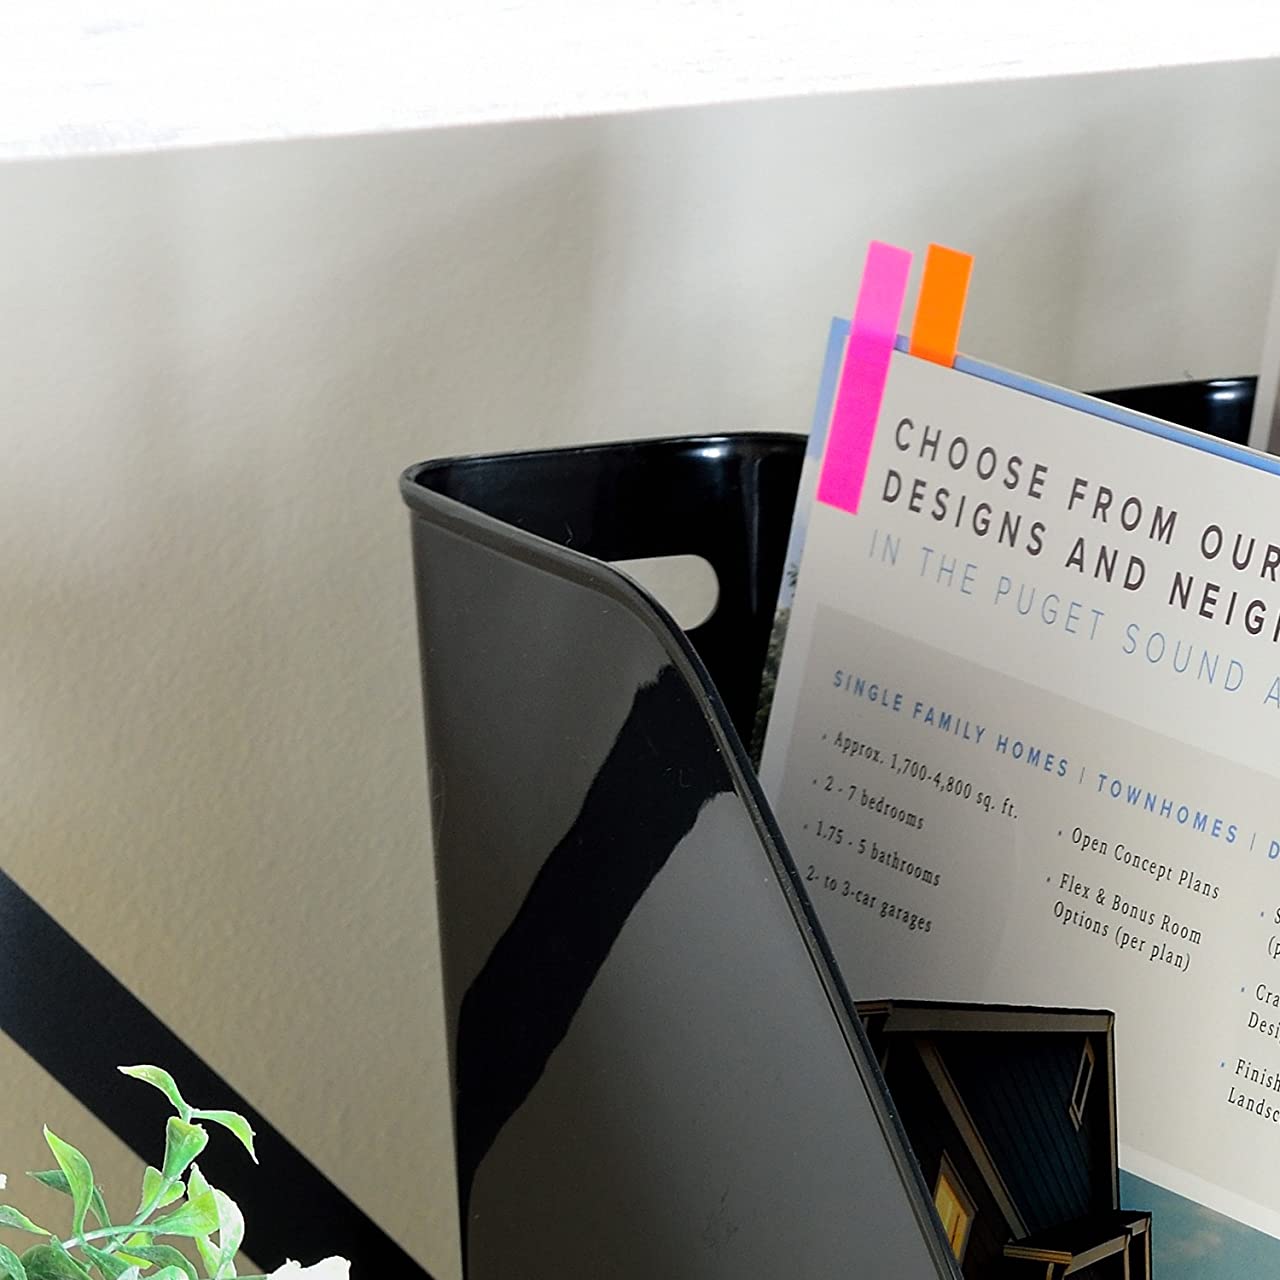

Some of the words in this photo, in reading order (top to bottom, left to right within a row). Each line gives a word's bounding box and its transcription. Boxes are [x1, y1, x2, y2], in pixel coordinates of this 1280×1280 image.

[895, 418, 1048, 499] CHOOSE
[1067, 477, 1178, 545] FROM
[882, 469, 1046, 556] DESIGNS
[1065, 537, 1145, 591] AND
[870, 530, 900, 565] IN
[921, 547, 977, 595] THE
[995, 576, 1104, 640] PUGET
[1122, 624, 1243, 691] SOUND
[833, 670, 903, 712] SINGLE
[913, 702, 986, 743] FAMILY
[996, 734, 1068, 777] HOMES
[1098, 774, 1237, 843] TOWNHOMES
[834, 731, 884, 764] Approx.
[890, 753, 972, 799] 1,700-4,800
[976, 792, 995, 812] sq.
[1001, 798, 1017, 819] ft.
[824, 776, 834, 791] 2
[848, 785, 857, 800] 7
[861, 789, 924, 829] bedrooms
[816, 821, 844, 844] 1.75
[858, 839, 866, 854] 5
[870, 842, 940, 886] bathrooms
[1072, 827, 1108, 855] Open
[1114, 844, 1172, 881] Concept
[1178, 870, 1219, 899] Plans
[806, 865, 819, 881] 2-
[824, 876, 837, 891] to
[842, 881, 876, 908] 3-car
[880, 902, 932, 932] garages
[1059, 873, 1090, 899] Flex
[1096, 888, 1106, 906] &
[1111, 895, 1155, 925] Bonus
[1160, 915, 1201, 944] Room
[1054, 901, 1109, 936] Options
[1115, 926, 1146, 951] (per
[1149, 943, 1190, 972] plan)
